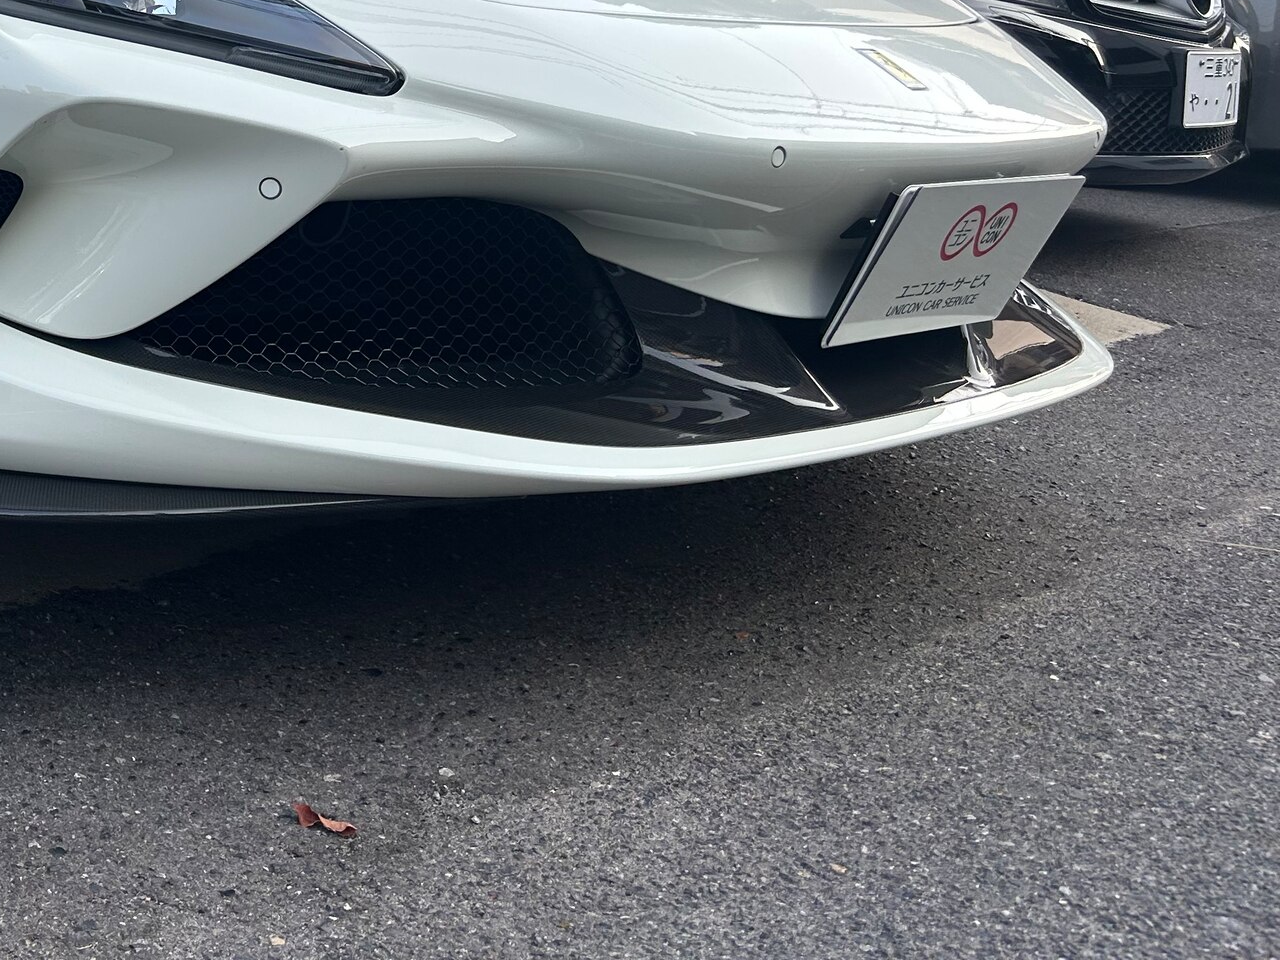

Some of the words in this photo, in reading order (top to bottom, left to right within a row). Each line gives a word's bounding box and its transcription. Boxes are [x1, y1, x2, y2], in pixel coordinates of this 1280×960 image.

[989, 215, 1010, 229] UNI
[980, 229, 1003, 244] CON
[895, 274, 991, 299] ユニコンカーサービス
[885, 302, 924, 317] UNICON
[922, 299, 943, 312] CAR
[942, 293, 980, 308] SERVICE
